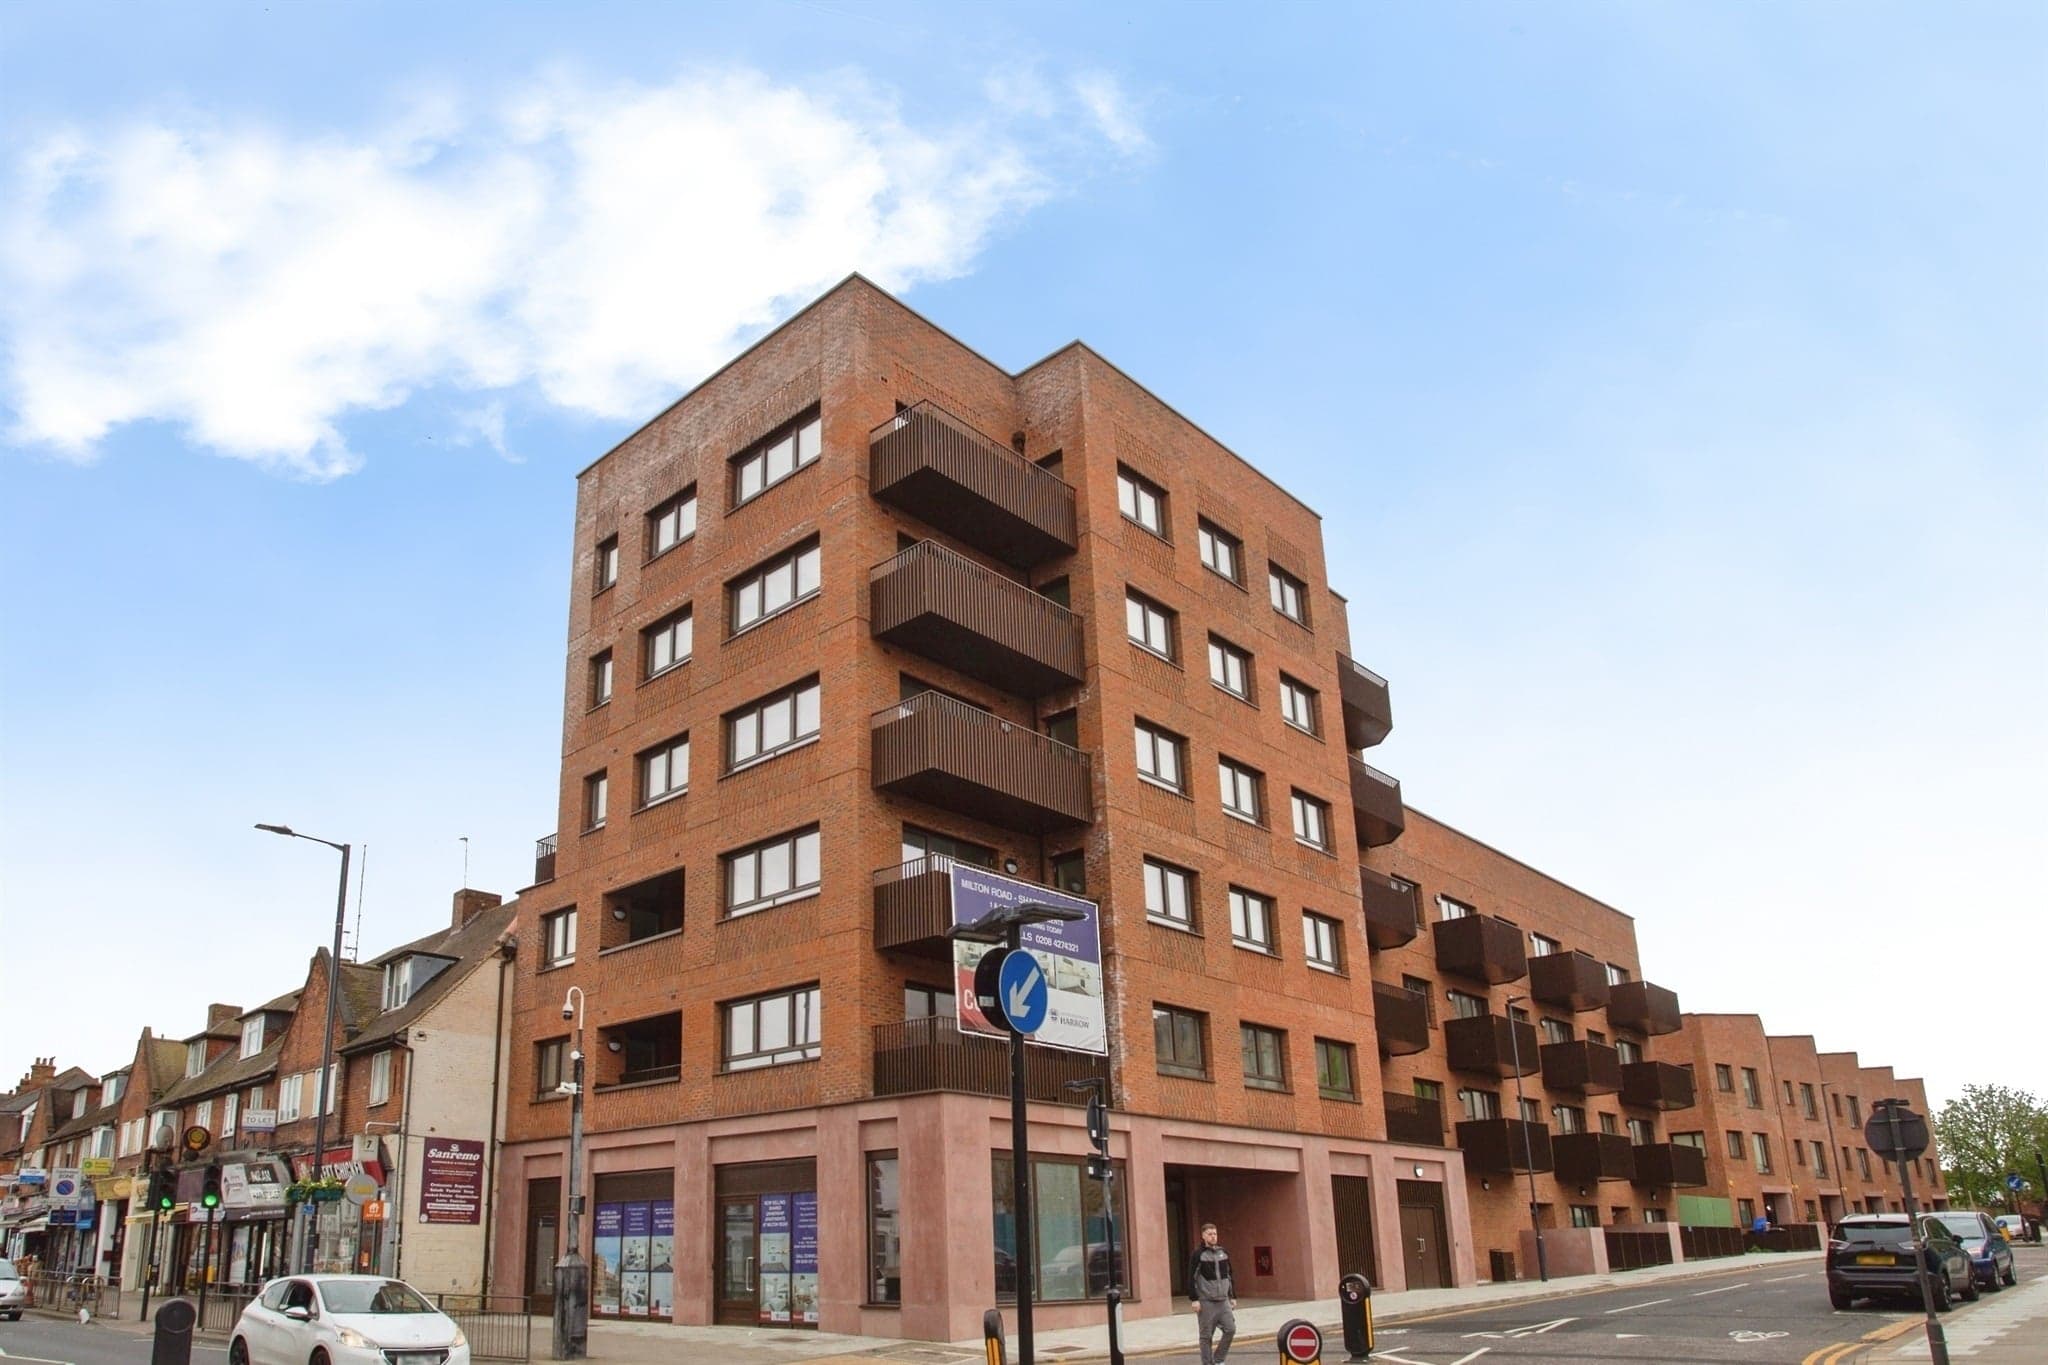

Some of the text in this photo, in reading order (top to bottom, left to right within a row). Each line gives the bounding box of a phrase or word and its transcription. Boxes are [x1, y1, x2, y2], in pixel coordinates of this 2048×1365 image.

[961, 879, 990, 895] MILTON
[991, 887, 1012, 901] ROAD
[1035, 934, 1052, 946] 0208
[1060, 1016, 1089, 1029] HARROW
[427, 1148, 480, 1161] Sanremo
